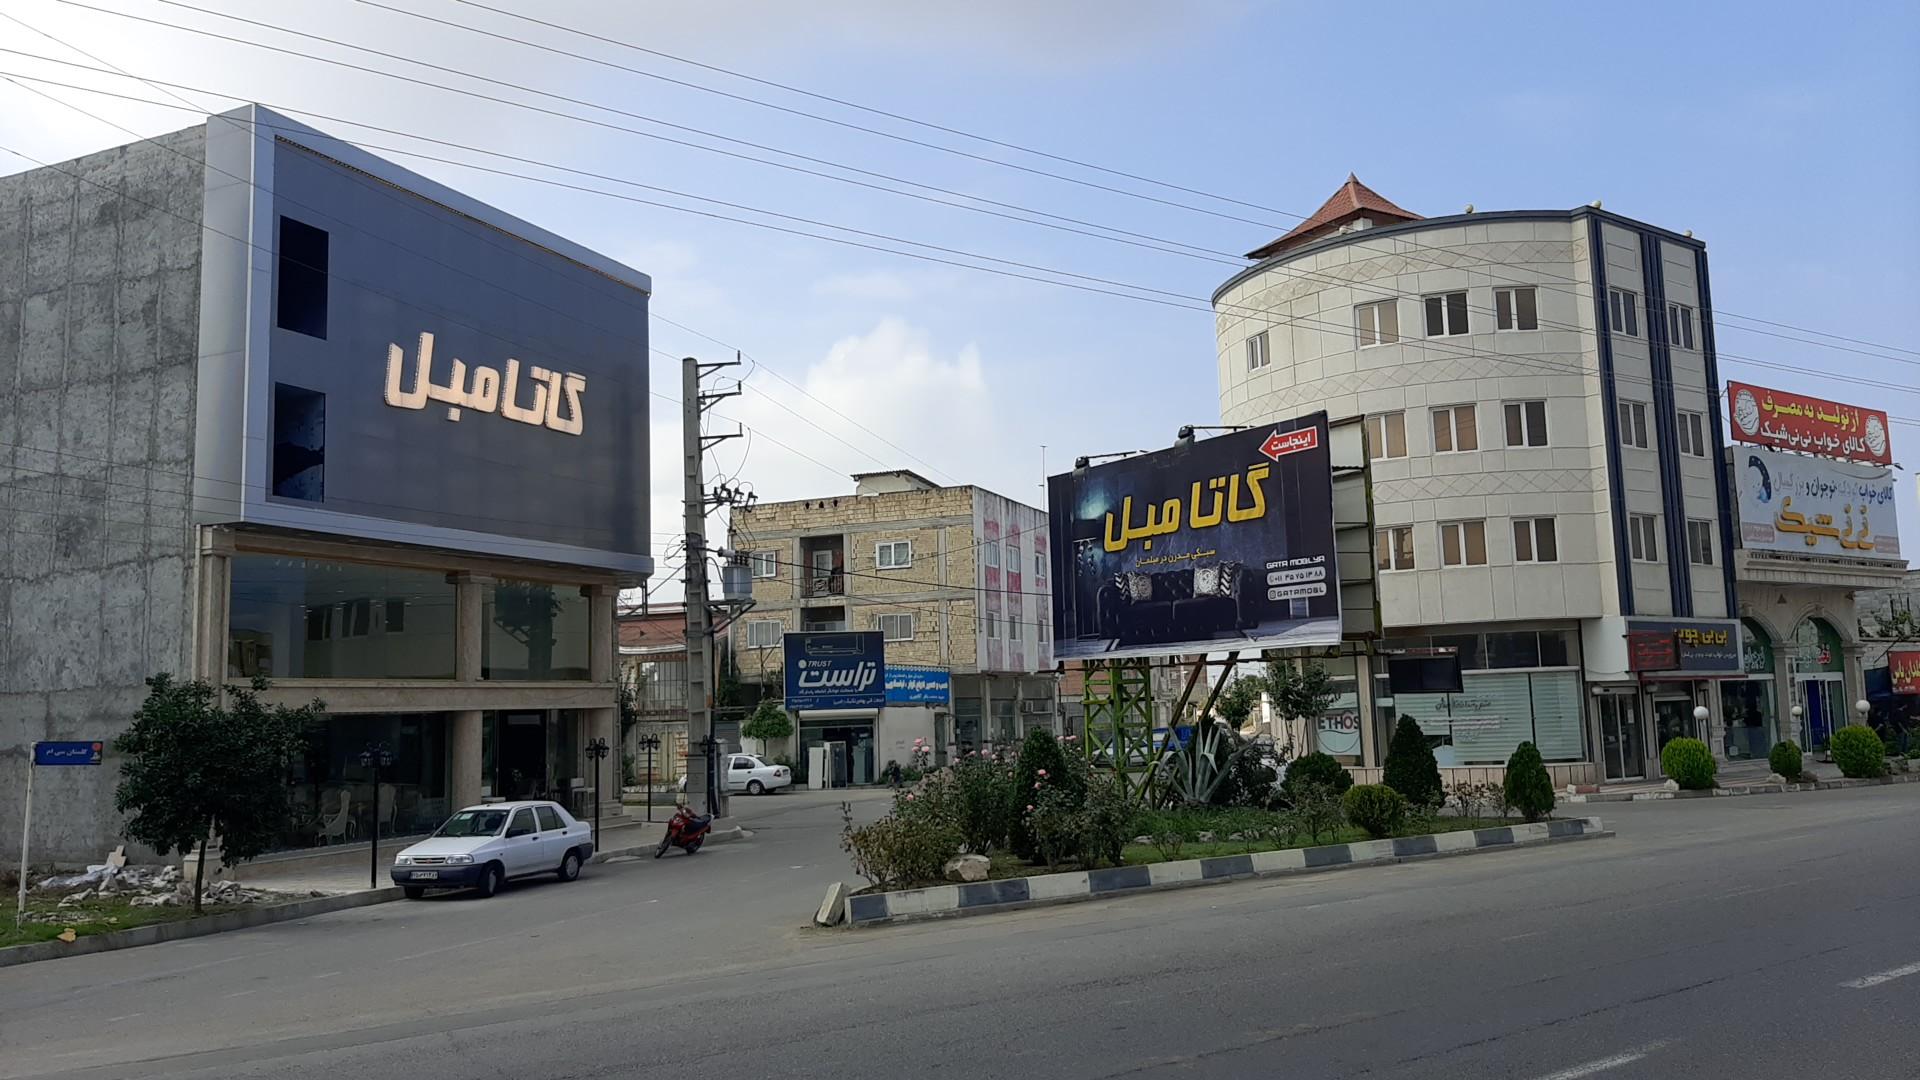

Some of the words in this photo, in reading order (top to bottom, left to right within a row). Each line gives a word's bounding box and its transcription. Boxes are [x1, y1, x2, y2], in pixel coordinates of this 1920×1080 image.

[384, 332, 500, 422] مبل
[500, 358, 587, 436] گاتا
[1762, 391, 1802, 418] مصرف
[1804, 404, 1814, 424] به
[1817, 406, 1850, 430] تولید
[1851, 408, 1860, 432] از
[1760, 421, 1788, 443] شیک
[1814, 432, 1840, 450] خواب
[1271, 435, 1311, 451] اینجاست
[1842, 435, 1865, 455] کالای
[1189, 462, 1270, 529] گاتا
[1859, 483, 1876, 504] خواب
[1876, 486, 1893, 504] کالای
[1104, 496, 1181, 552] مبل
[1136, 556, 1159, 567] مبلمان
[1160, 555, 1167, 564] در
[1168, 552, 1190, 563] مدرن
[1266, 560, 1288, 569] GATA
[808, 660, 832, 668] TRUST
[799, 661, 877, 691] تراست
[1318, 715, 1359, 730] ETHOS
[66, 748, 88, 757] گلستان
